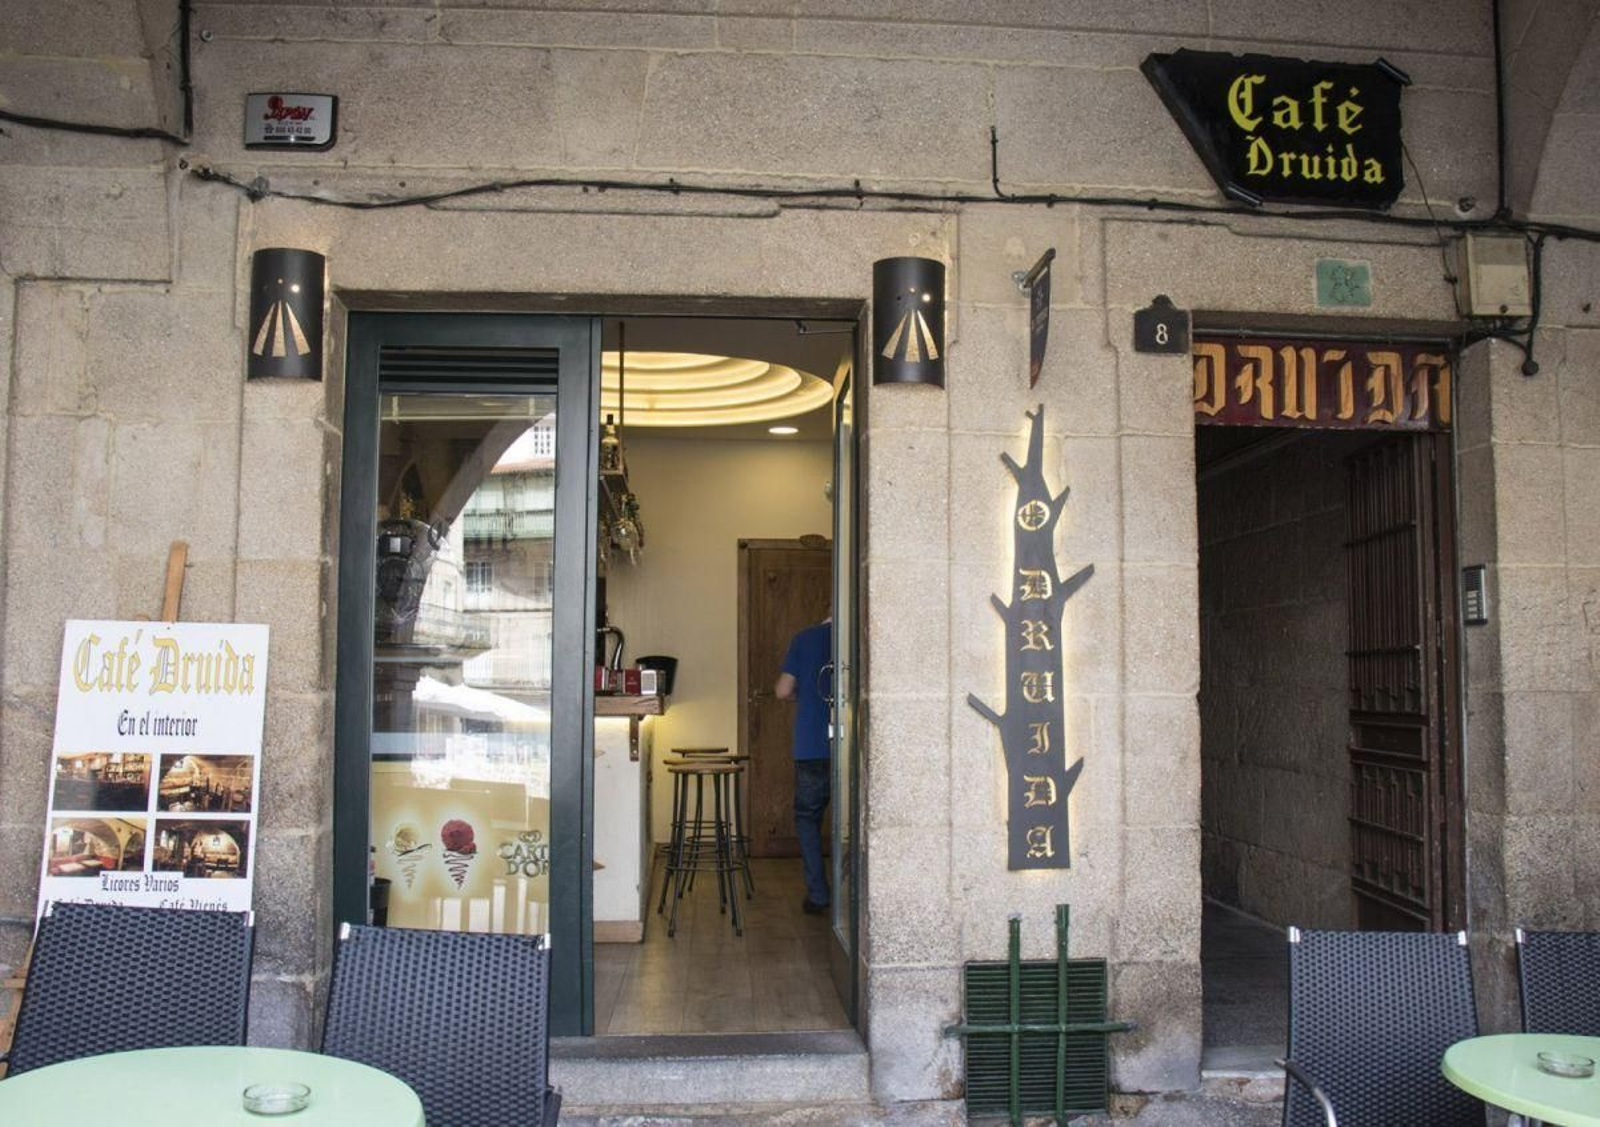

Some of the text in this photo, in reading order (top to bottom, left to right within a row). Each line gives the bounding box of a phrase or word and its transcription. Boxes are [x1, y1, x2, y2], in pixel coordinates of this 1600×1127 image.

[1228, 73, 1365, 136] Café
[1246, 135, 1385, 185] Druida
[1155, 323, 1169, 345] 8
[73, 629, 255, 696] Café Druida
[117, 709, 198, 737] En el interior
[1018, 567, 1057, 859] DRUIDA
[101, 873, 179, 893] Licores Varios
